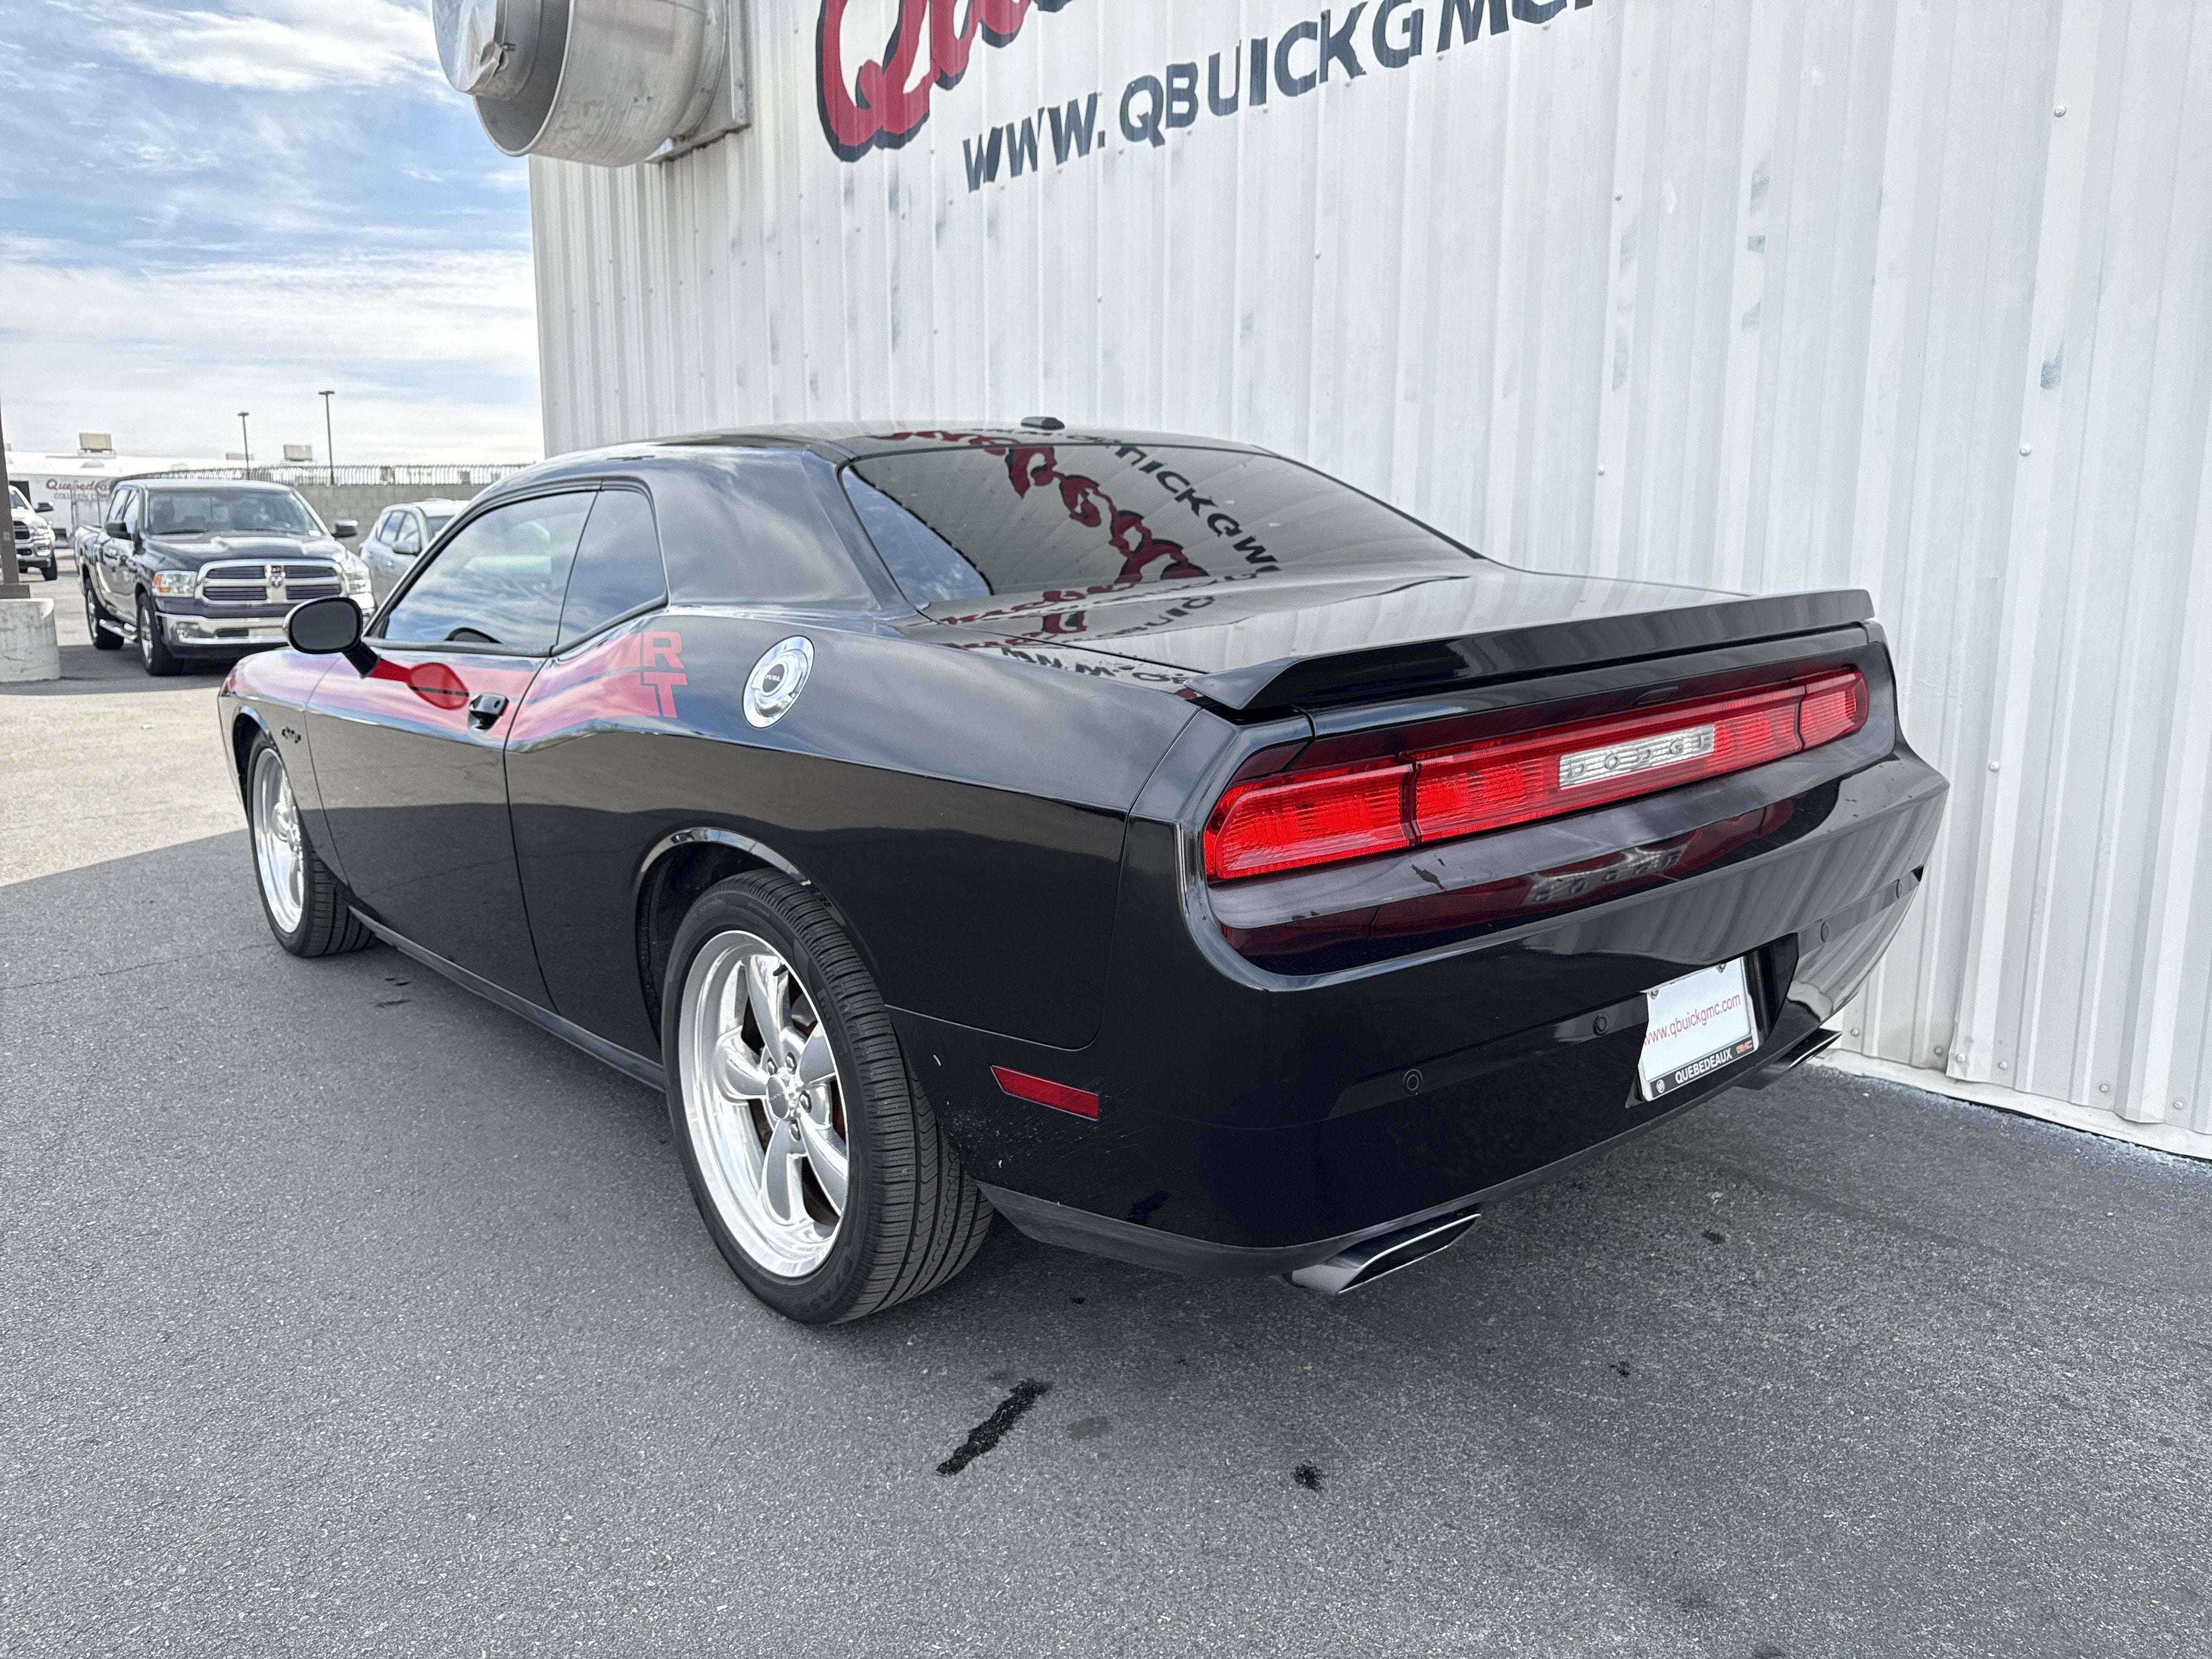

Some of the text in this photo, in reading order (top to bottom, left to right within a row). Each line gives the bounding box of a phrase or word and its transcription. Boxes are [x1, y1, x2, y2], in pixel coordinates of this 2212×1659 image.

[1567, 733, 1713, 778] DODGE
[1675, 1039, 1753, 1084] QUEBEDEAUX GMC
